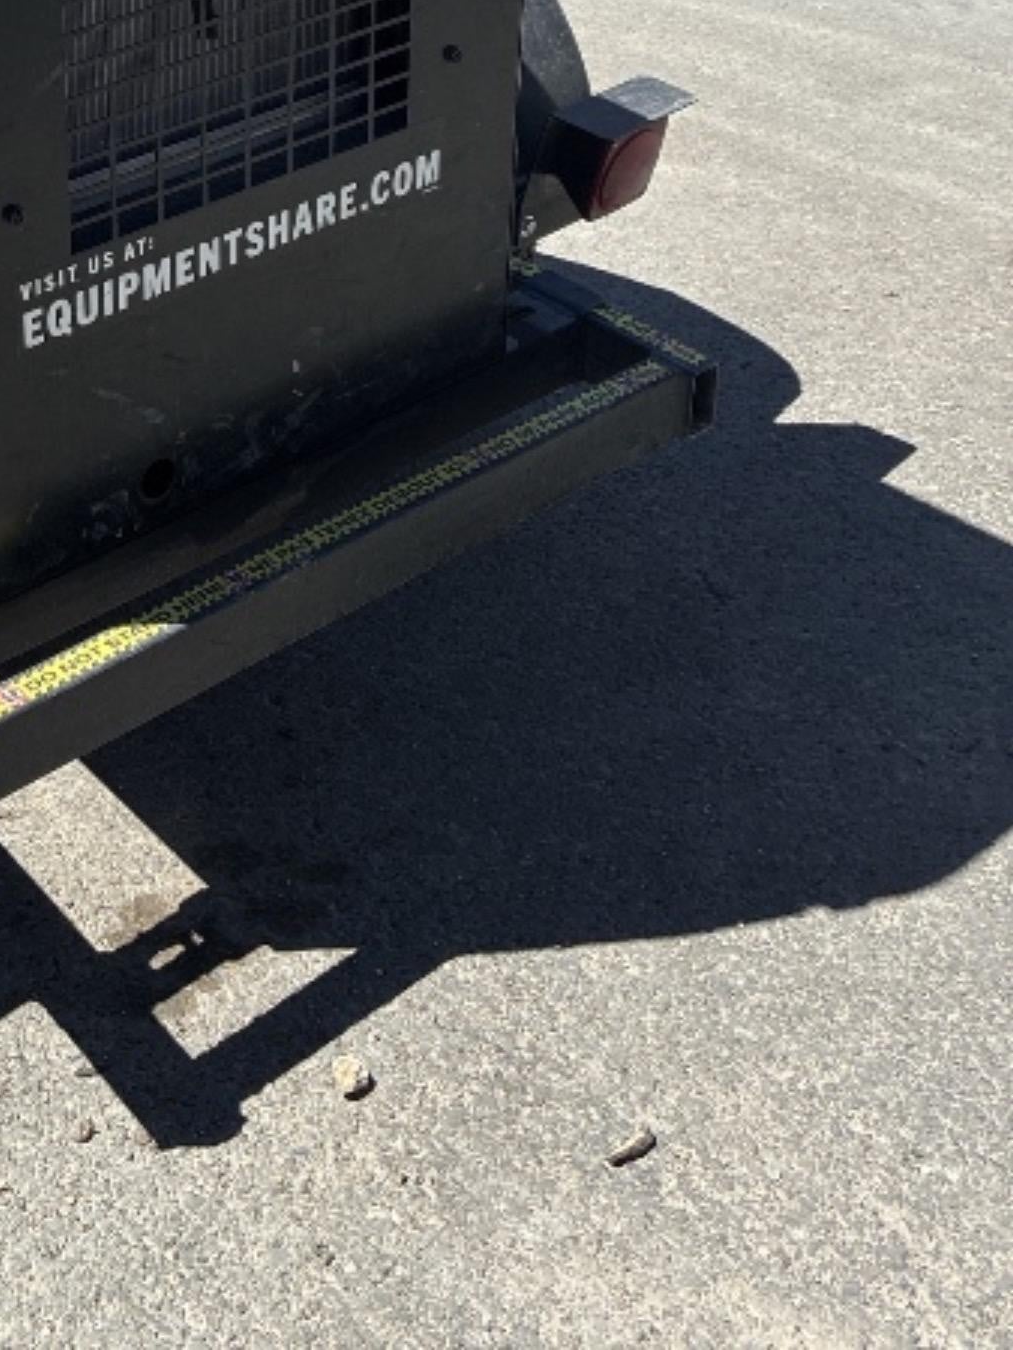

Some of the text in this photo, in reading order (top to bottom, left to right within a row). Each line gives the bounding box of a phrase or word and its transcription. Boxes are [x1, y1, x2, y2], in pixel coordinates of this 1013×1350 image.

[18, 236, 155, 302] VISIT US AT:
[22, 149, 442, 349] EQUIPMENTSHARE.COM
